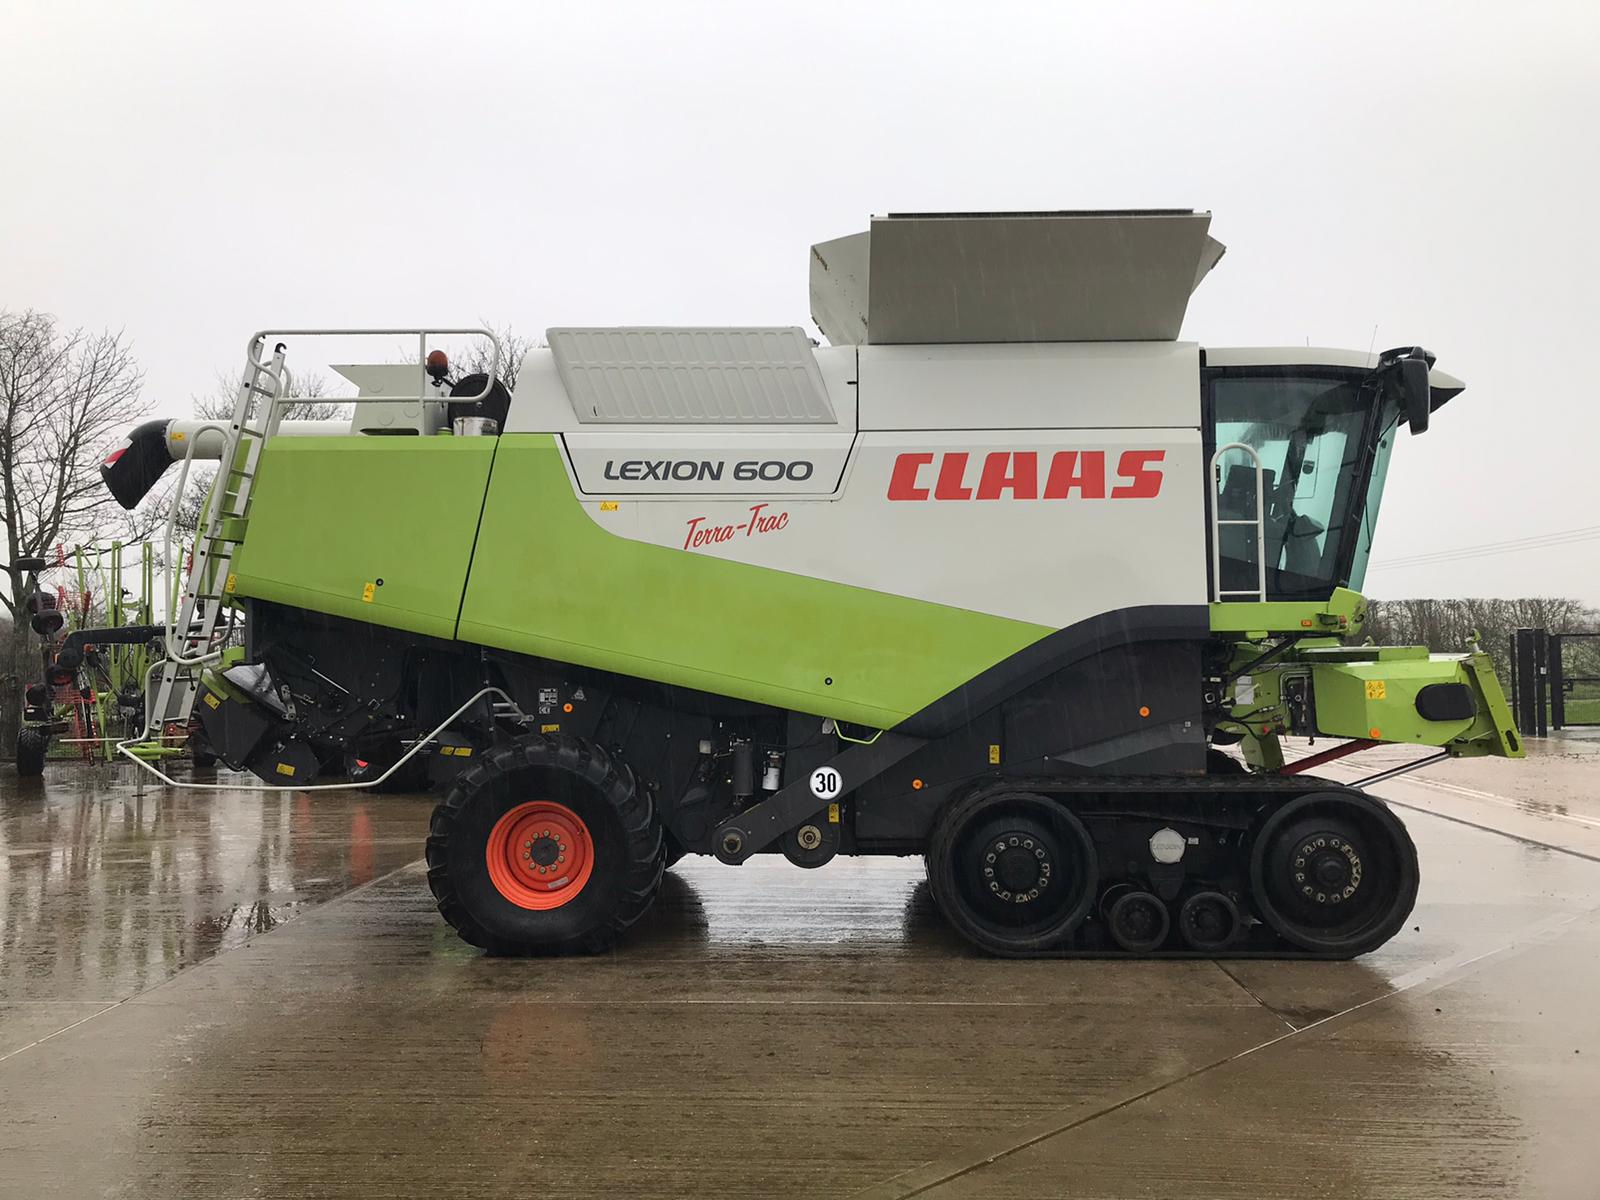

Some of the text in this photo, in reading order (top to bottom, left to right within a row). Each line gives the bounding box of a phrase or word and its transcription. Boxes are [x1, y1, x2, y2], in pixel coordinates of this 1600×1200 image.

[603, 460, 814, 482] LEXION 600
[886, 449, 1166, 502] CLAAS
[683, 503, 790, 551] Terra-Trac
[815, 772, 837, 793] 30
